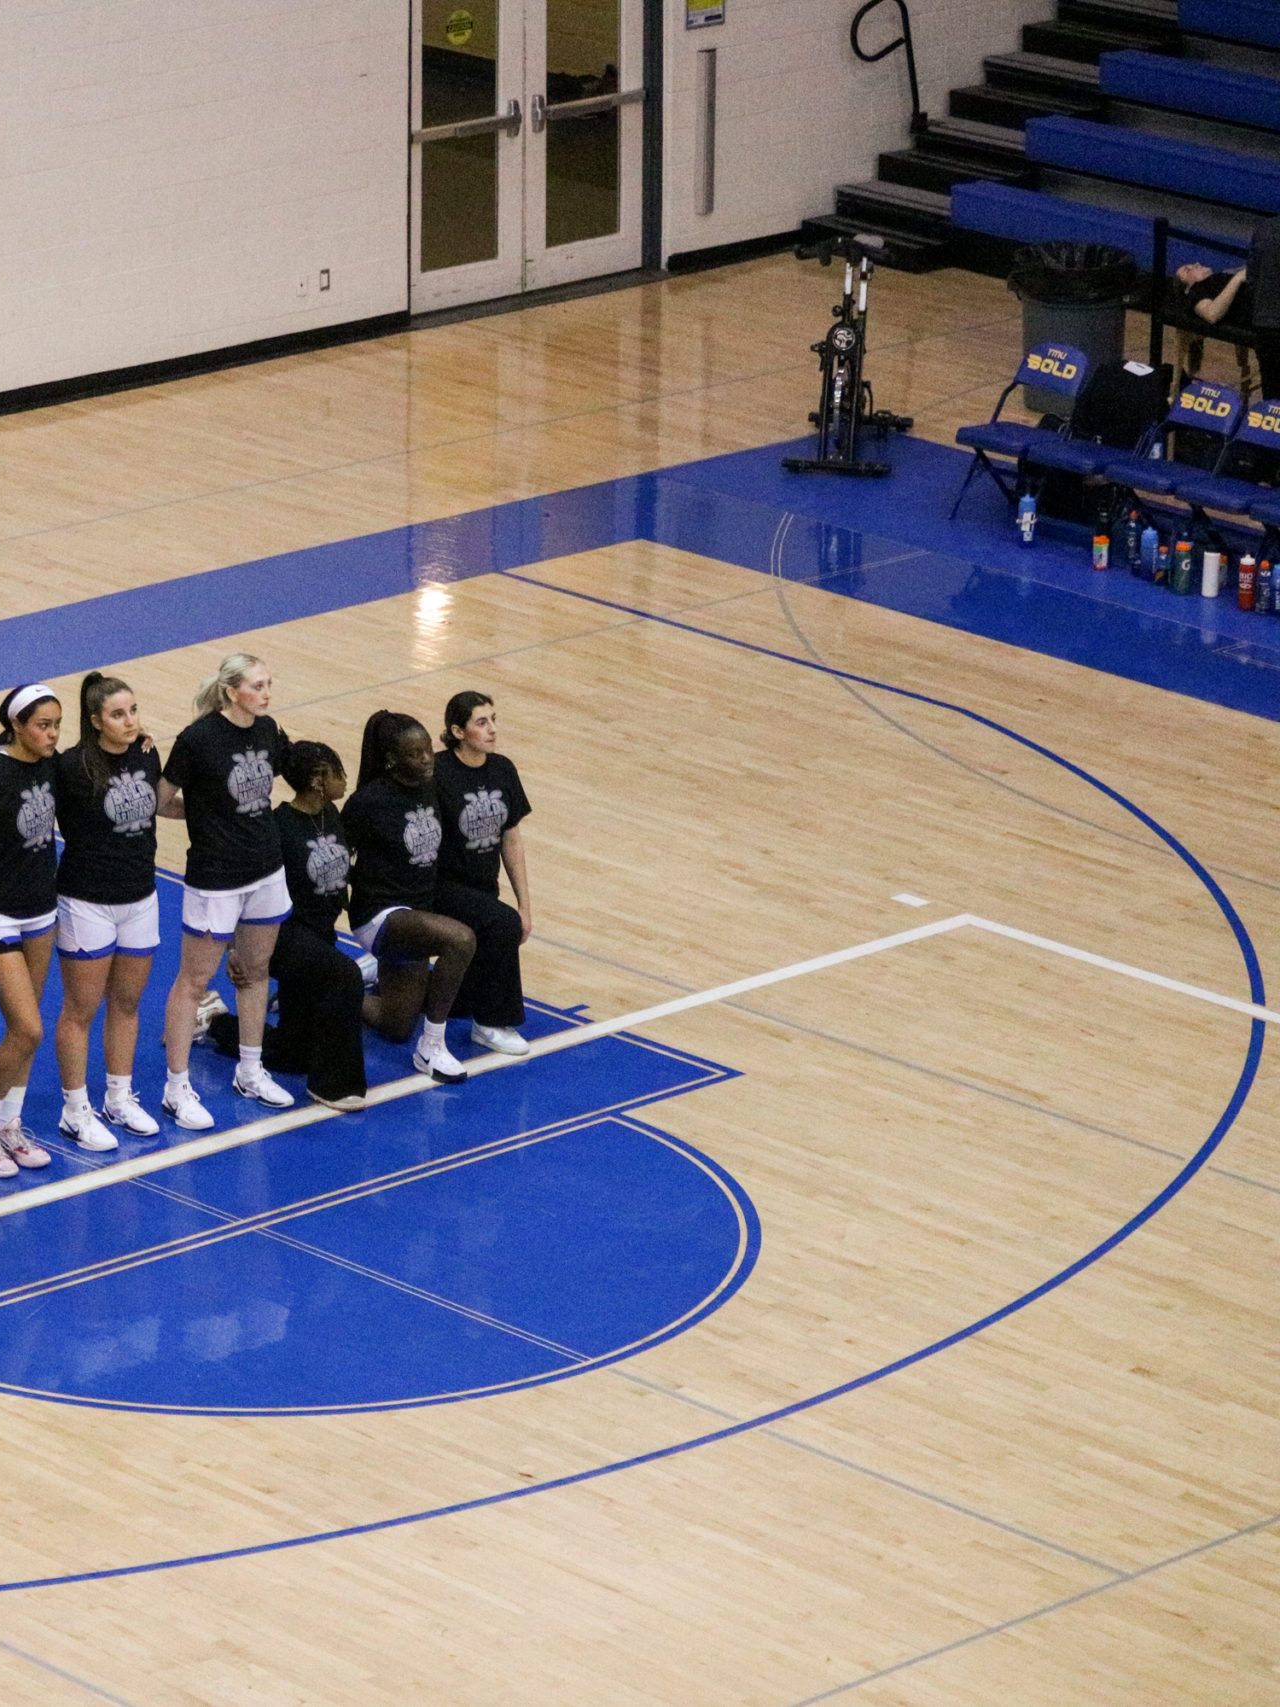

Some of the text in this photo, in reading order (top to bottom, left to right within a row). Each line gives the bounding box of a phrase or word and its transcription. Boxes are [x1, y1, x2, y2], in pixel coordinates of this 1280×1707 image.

[1047, 348, 1068, 360] TMU
[1027, 353, 1077, 379] BOLD
[1200, 386, 1221, 398] TMU
[1180, 392, 1231, 417] BOLD
[1268, 404, 1280, 415] TM
[1248, 411, 1280, 434] BOL
[1181, 558, 1191, 571] G
